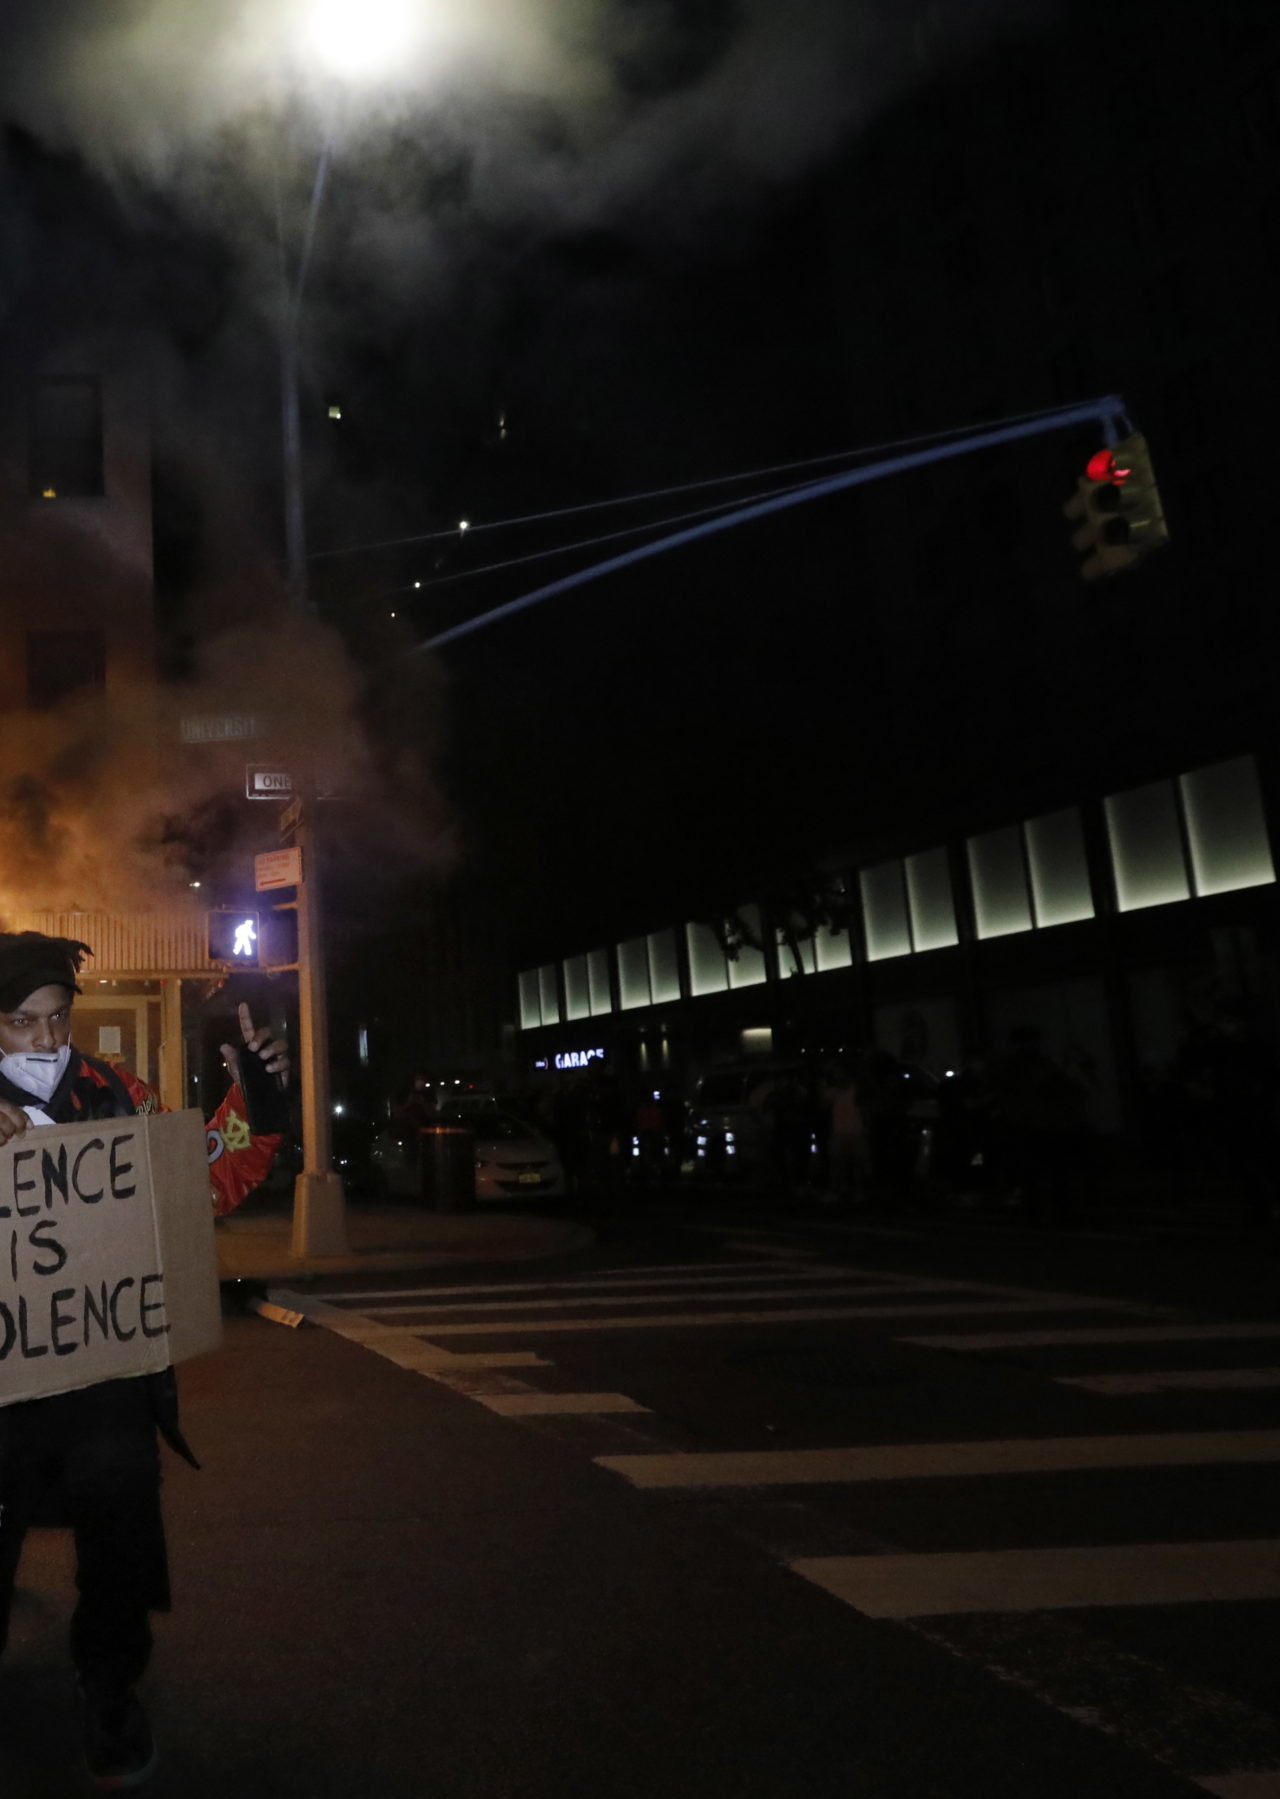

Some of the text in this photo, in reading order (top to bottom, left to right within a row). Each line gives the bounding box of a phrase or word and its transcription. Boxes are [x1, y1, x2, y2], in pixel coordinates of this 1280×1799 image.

[182, 719, 256, 741] UNIVERSIT
[263, 775, 291, 788] ONE
[11, 1220, 68, 1282] IS
